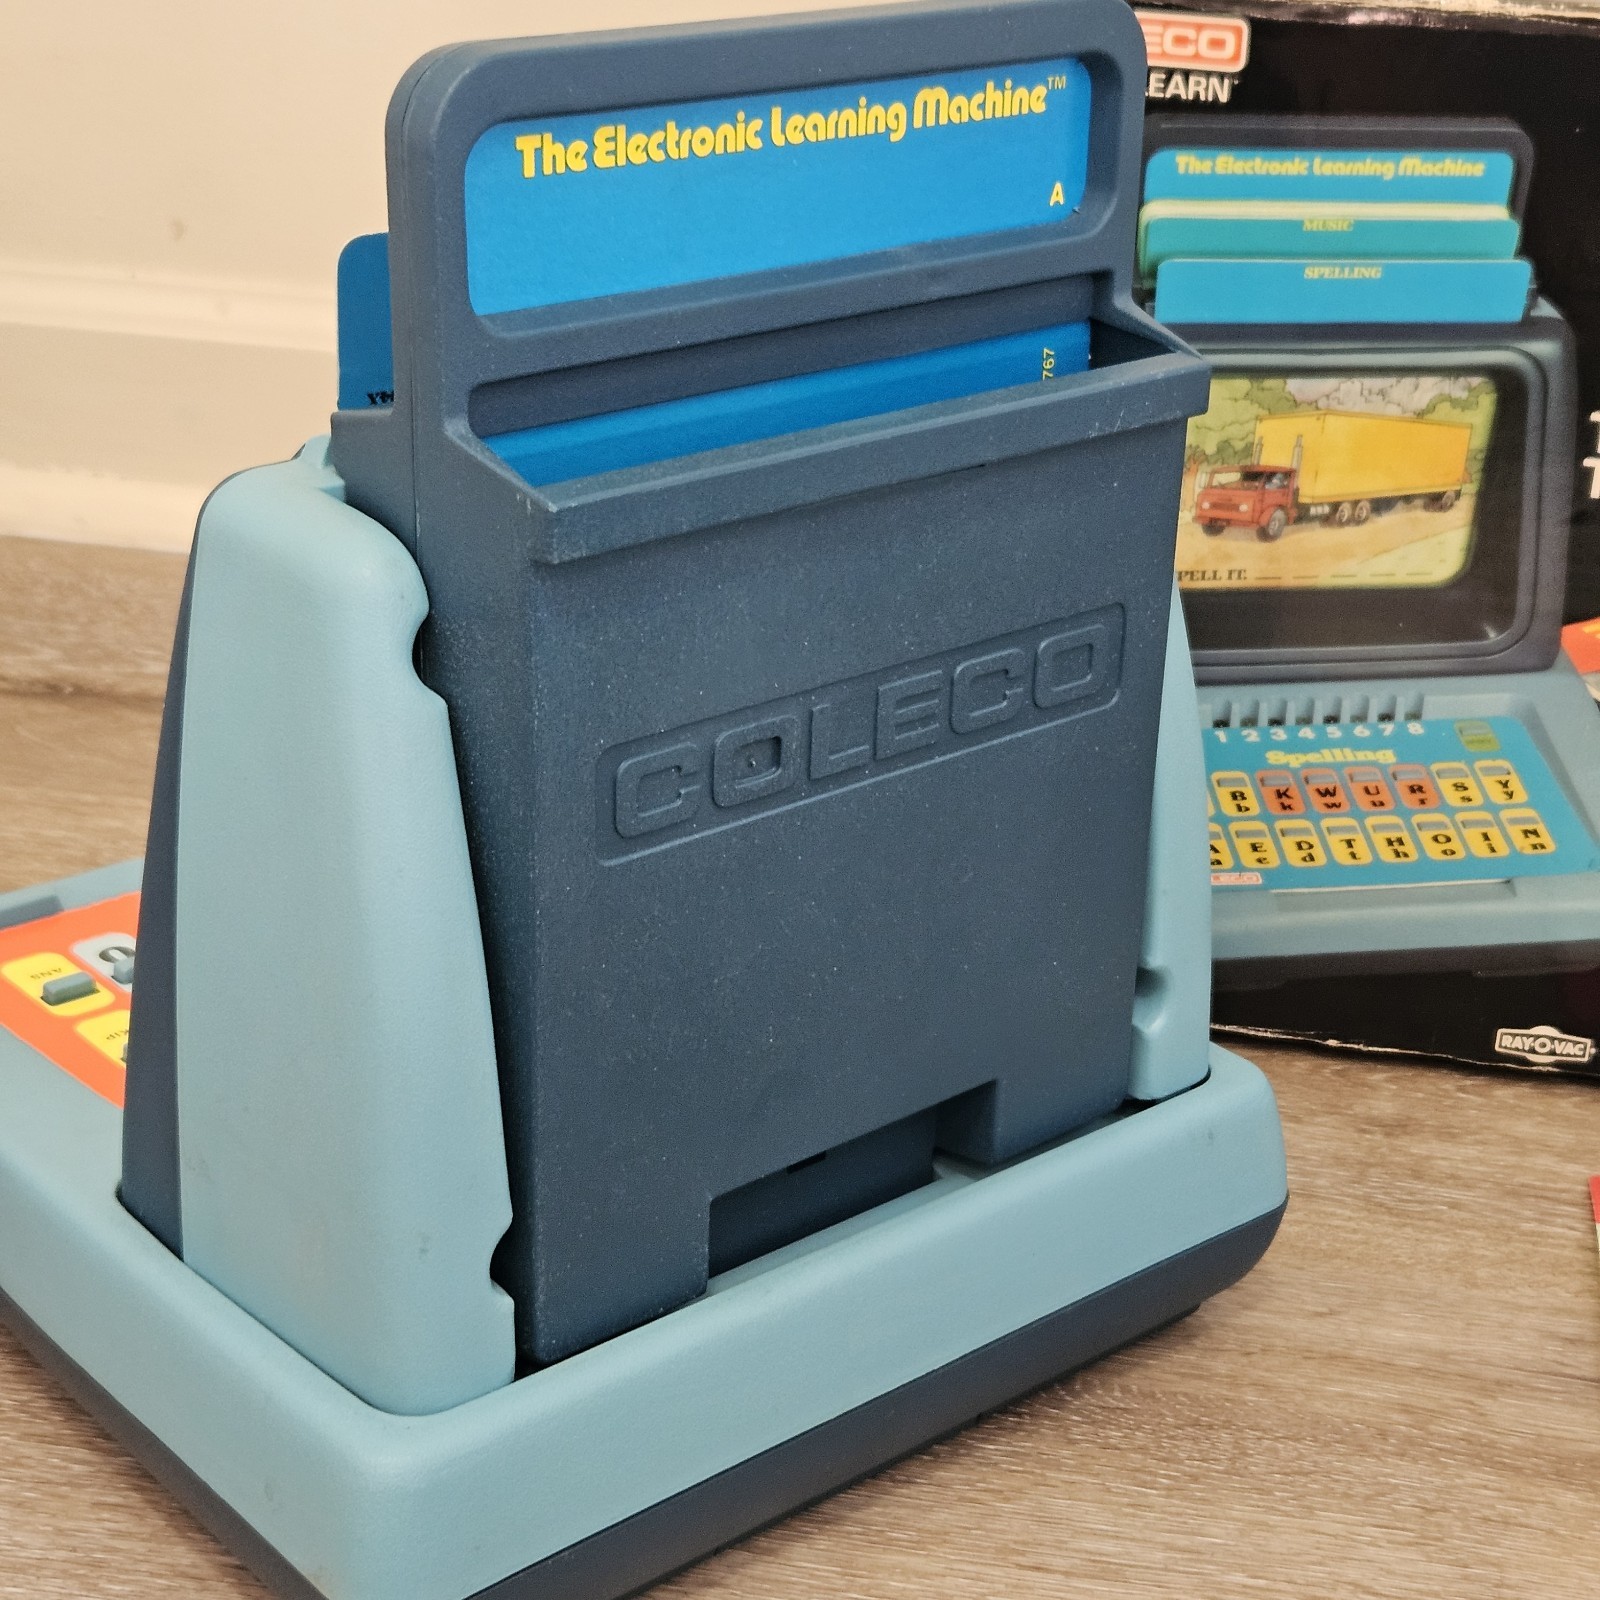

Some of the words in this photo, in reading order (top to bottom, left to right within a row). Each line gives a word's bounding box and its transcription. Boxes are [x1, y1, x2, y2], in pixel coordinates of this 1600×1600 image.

[515, 132, 588, 179] The
[593, 110, 764, 169] Electronic
[770, 97, 907, 143] Learning
[1176, 154, 1212, 175] The
[1215, 154, 1308, 176] Electronic
[1313, 156, 1395, 180] Learning
[1398, 156, 1485, 177] Machine
[1049, 181, 1065, 207] A
[1303, 218, 1355, 232] MUSIC
[1304, 266, 1382, 279] SPELLING
[615, 623, 1110, 839] COLECO
[1214, 730, 1227, 743] 1
[1241, 729, 1260, 742] 2
[1270, 729, 1287, 740] 3
[1298, 727, 1316, 739] 4
[1326, 726, 1342, 738] 5
[1353, 725, 1370, 737] 6
[1379, 723, 1395, 736] 7
[1407, 722, 1424, 735] 8
[1265, 748, 1396, 768] Spelling
[1275, 787, 1294, 799] K
[1315, 785, 1337, 798] W
[1363, 785, 1380, 796] U
[1496, 779, 1510, 789] Y
[1250, 842, 1267, 853] E
[1295, 840, 1314, 851] D
[1339, 838, 1356, 849] T
[1385, 836, 1405, 847] H
[1431, 833, 1452, 844] O
[1520, 828, 1541, 839] N
